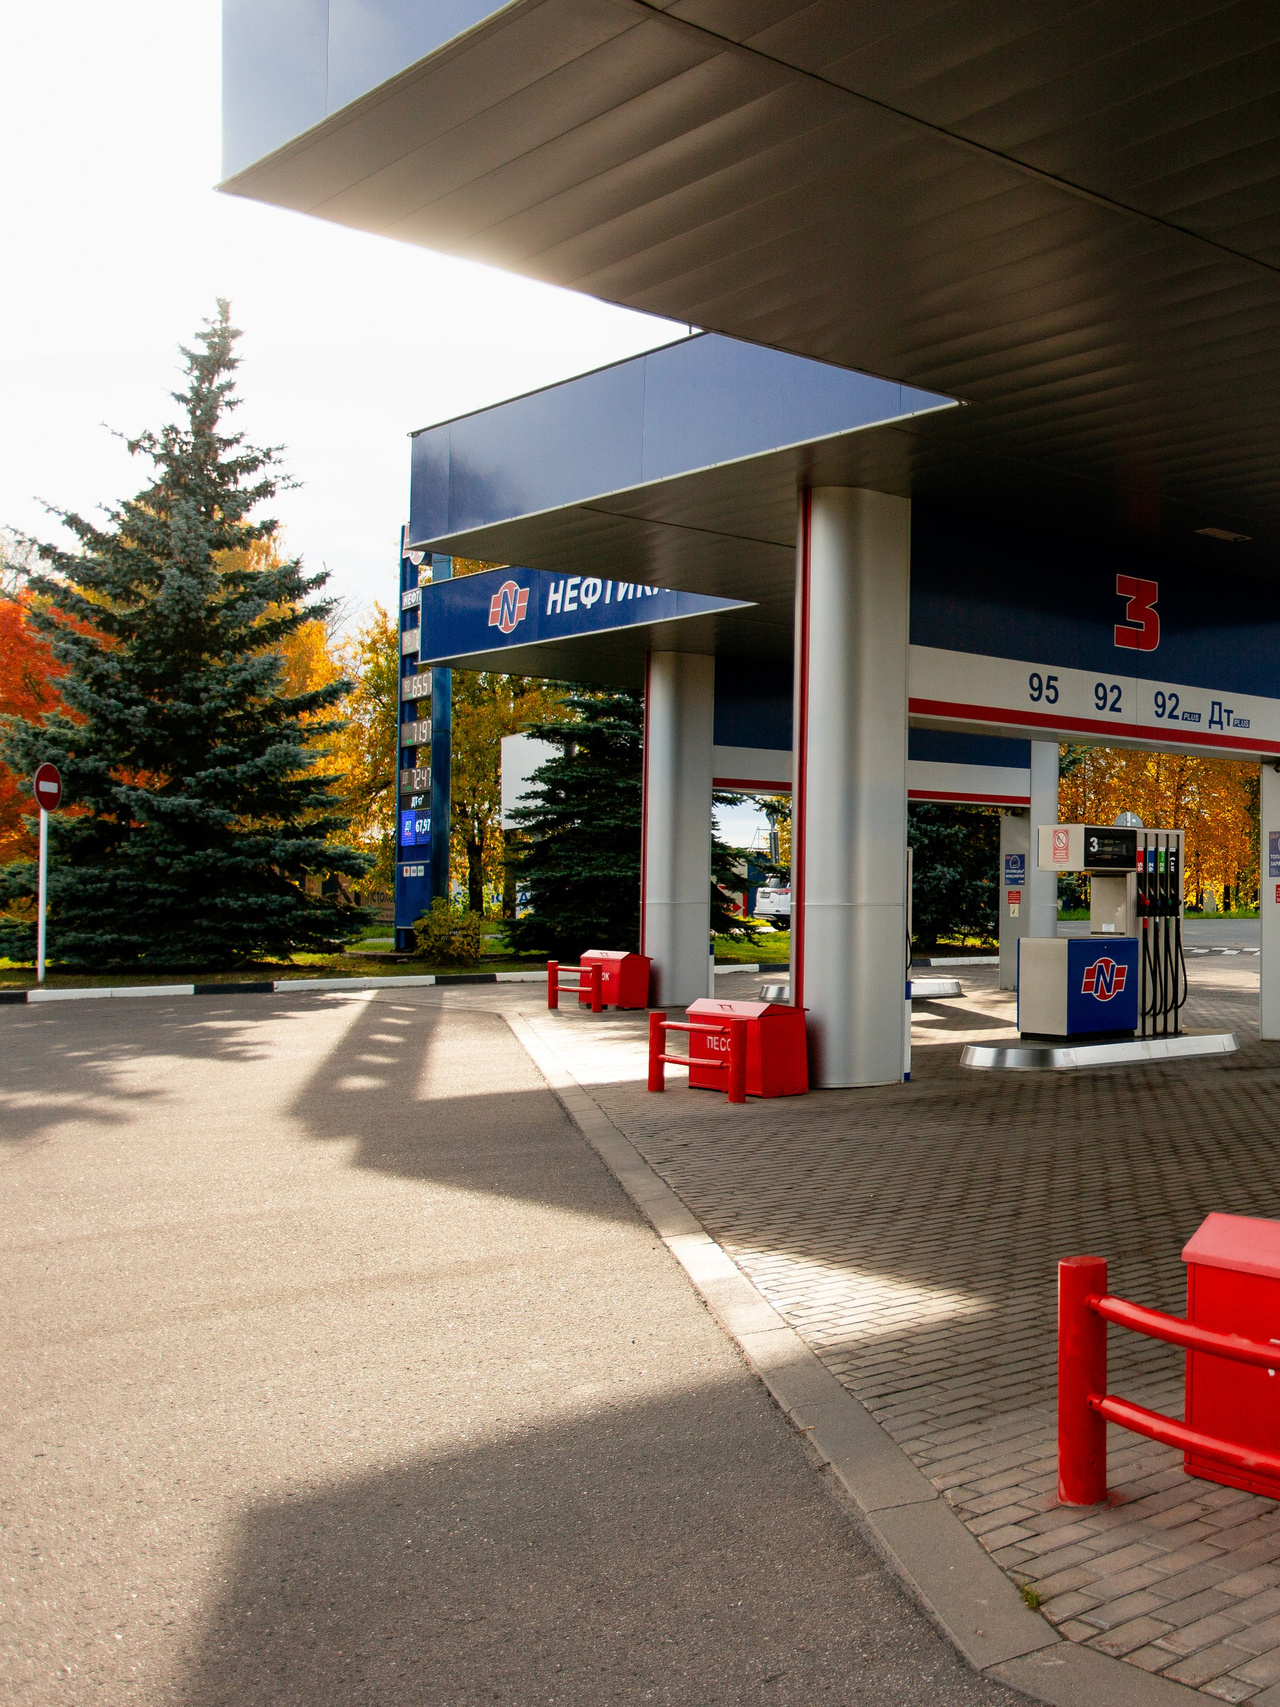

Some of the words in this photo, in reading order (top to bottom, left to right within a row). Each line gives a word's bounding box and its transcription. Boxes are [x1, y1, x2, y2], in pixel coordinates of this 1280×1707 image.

[1113, 573, 1161, 652] 3
[1029, 673, 1059, 704] 95
[1094, 682, 1122, 713] 92
[1154, 690, 1180, 720] 92
[1183, 712, 1201, 722] PLUS
[1234, 719, 1250, 728] PLUS
[1090, 837, 1098, 852] 3
[1138, 862, 1143, 871] 95
[1148, 862, 1154, 872] 92
